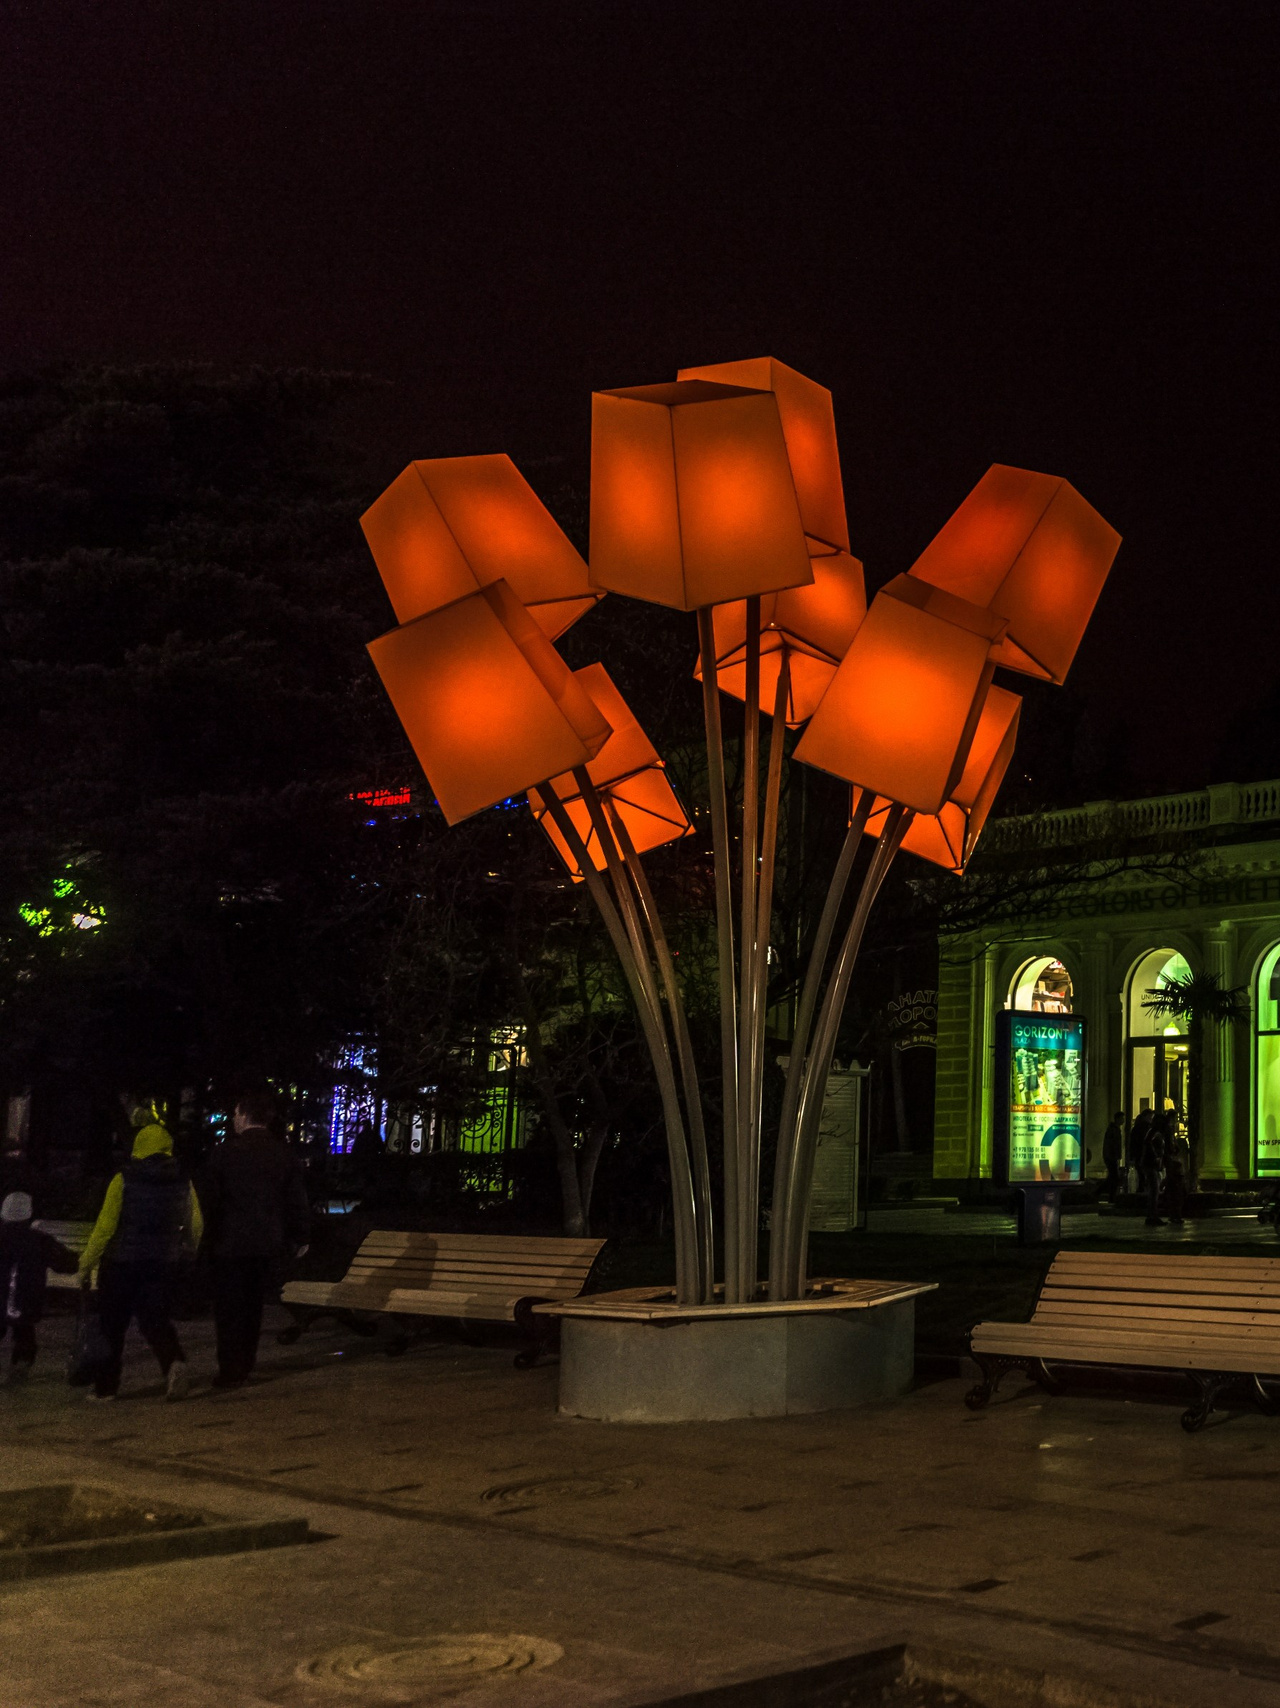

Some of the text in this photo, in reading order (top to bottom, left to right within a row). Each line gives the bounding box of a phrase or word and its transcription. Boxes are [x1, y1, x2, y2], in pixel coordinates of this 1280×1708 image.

[1067, 889, 1154, 918] COLORS
[1161, 885, 1187, 909] OF
[1014, 1025, 1069, 1040] GORIZONT
